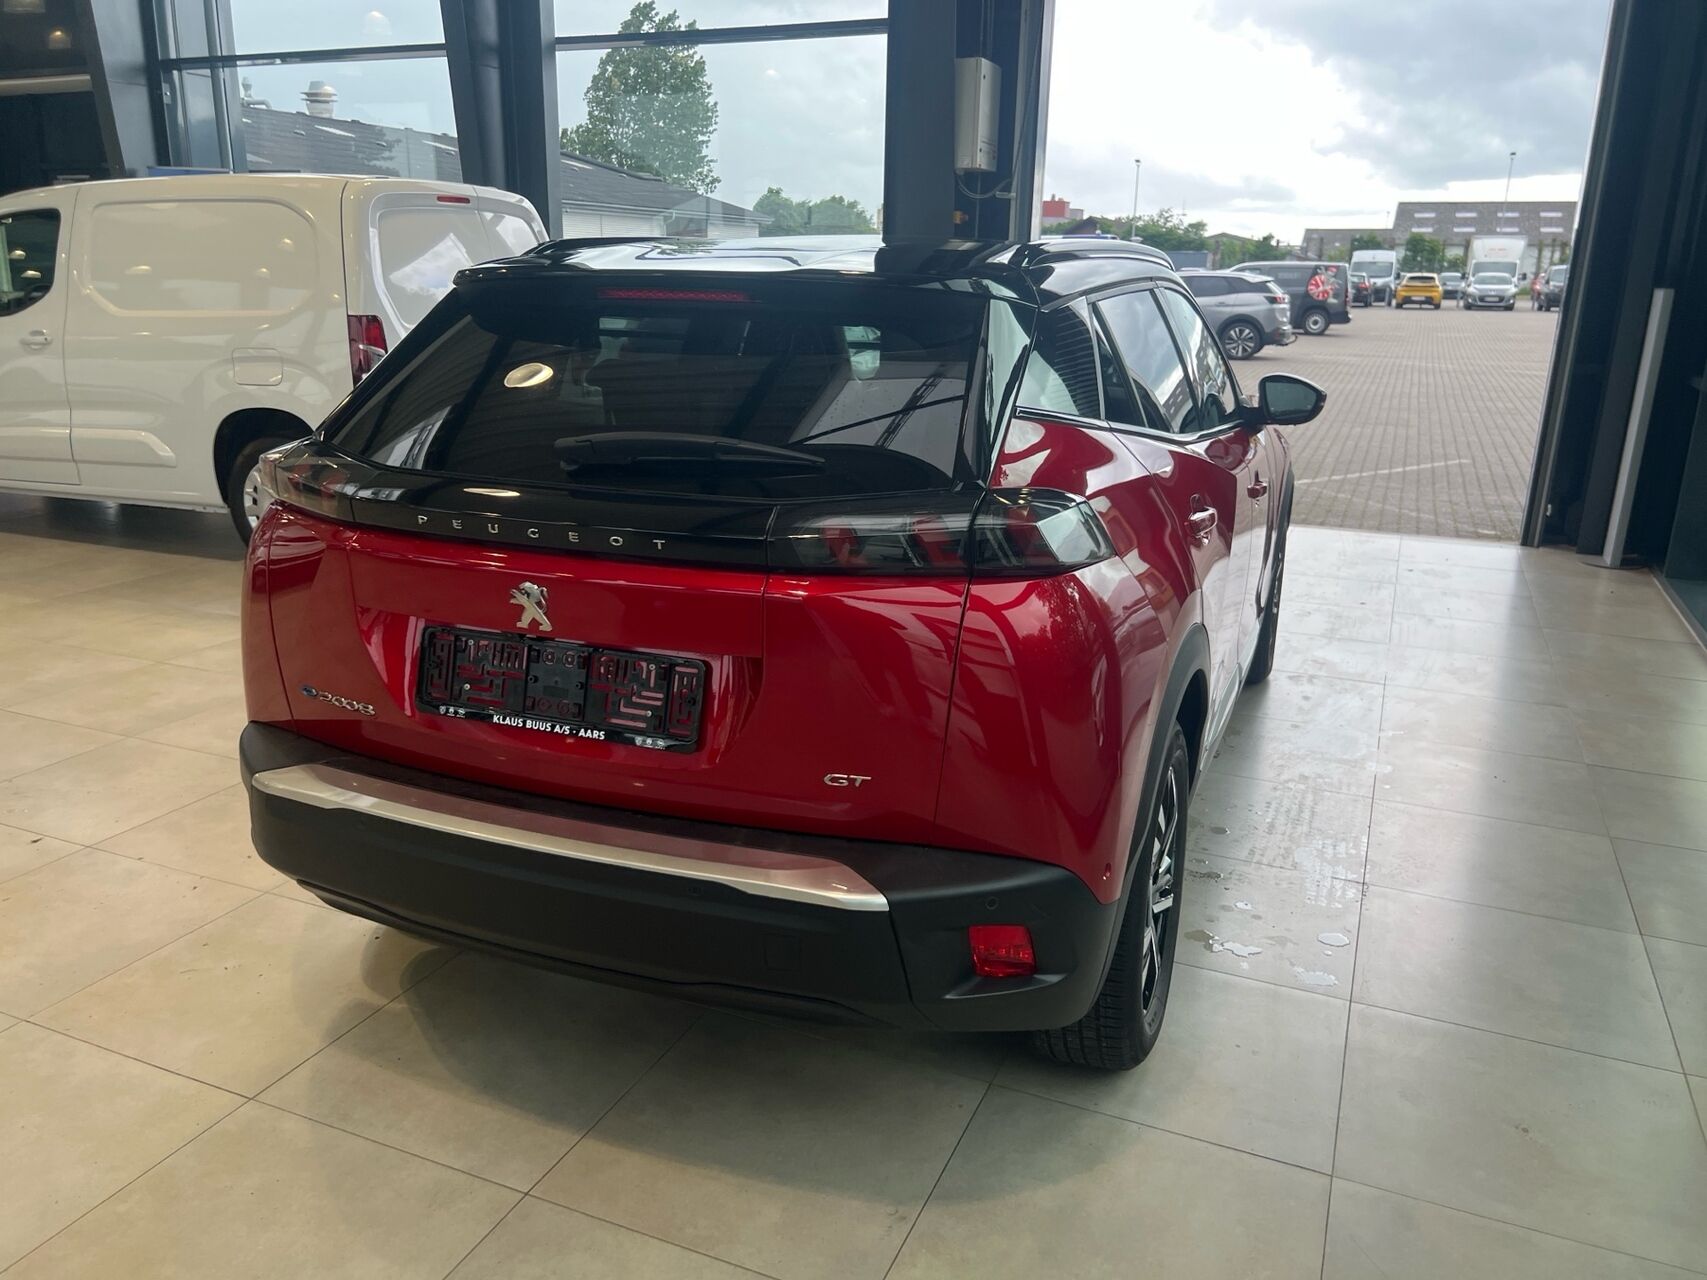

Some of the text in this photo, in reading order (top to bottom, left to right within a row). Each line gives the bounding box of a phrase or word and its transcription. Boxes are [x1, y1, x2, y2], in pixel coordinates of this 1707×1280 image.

[417, 515, 666, 550] PEUGEOT
[492, 713, 606, 741] KLAUS BUUS A/S AARS
[823, 773, 872, 787] GT
